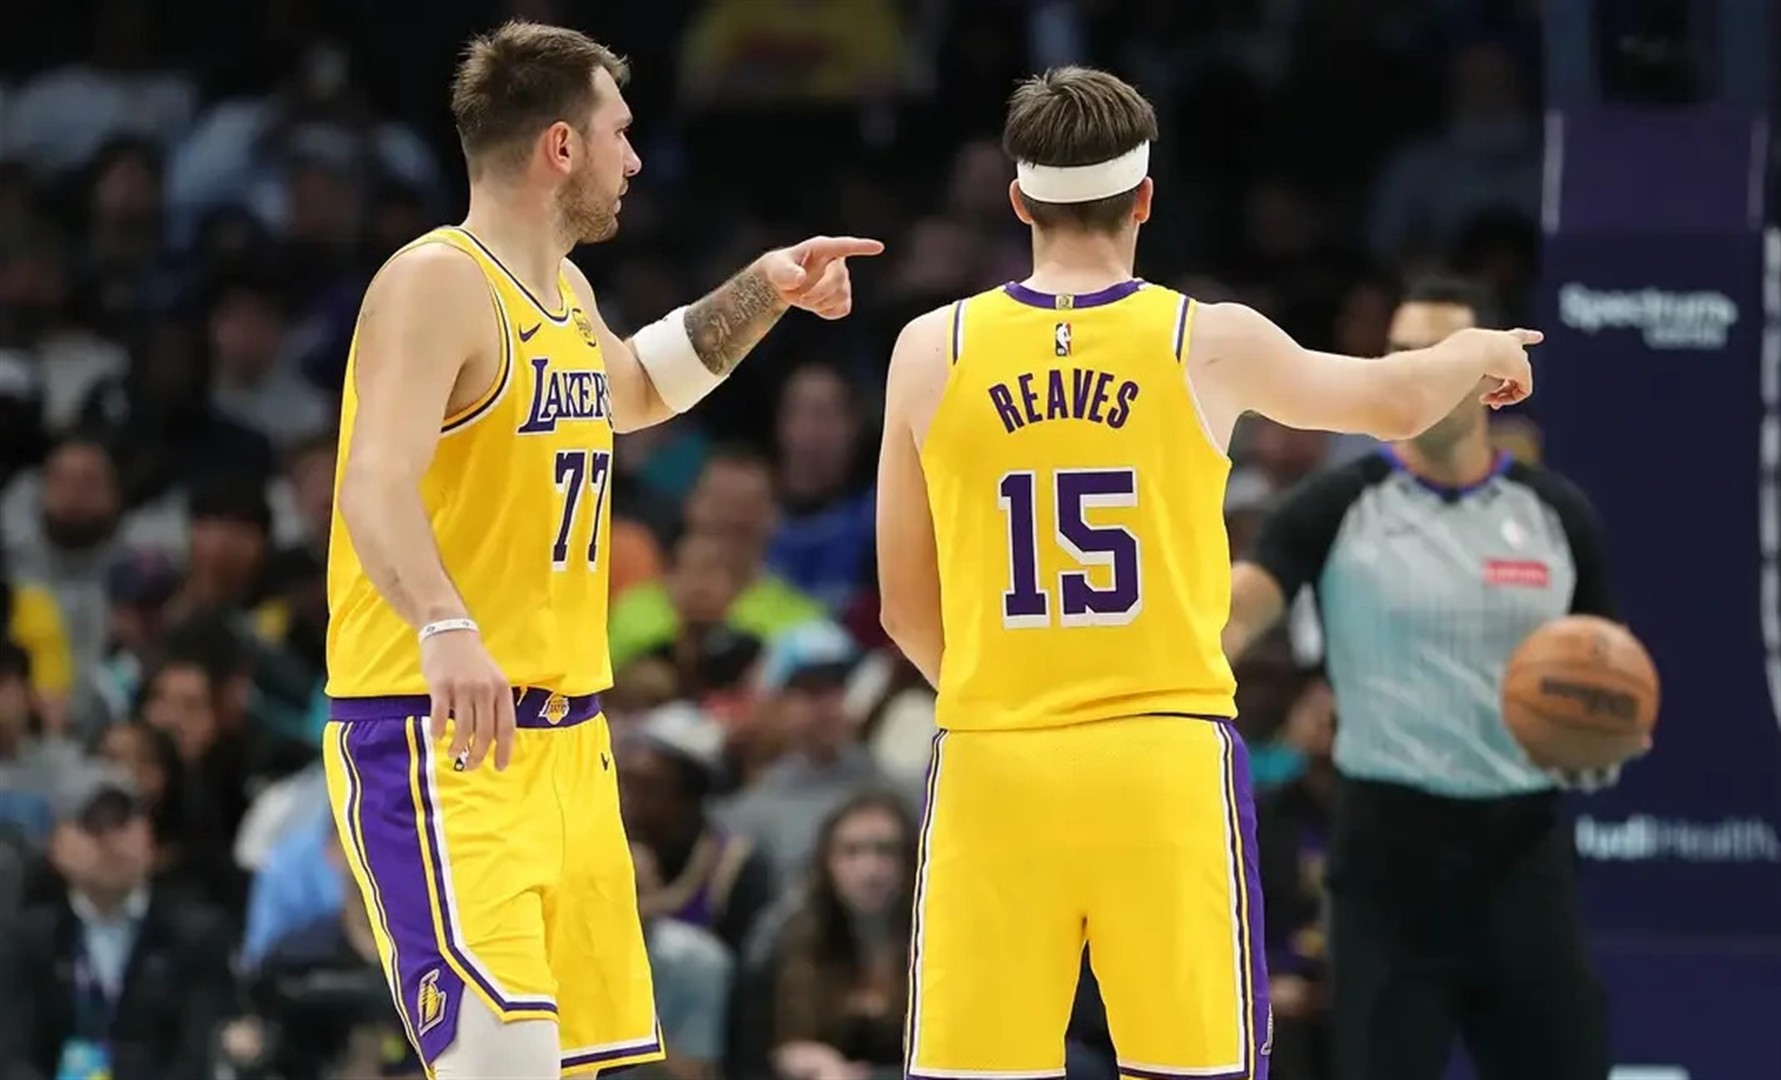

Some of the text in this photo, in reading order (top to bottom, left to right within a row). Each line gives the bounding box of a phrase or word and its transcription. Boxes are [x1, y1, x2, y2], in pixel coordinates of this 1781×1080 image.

[988, 368, 1139, 433] REAVES
[551, 450, 610, 572] 77
[998, 468, 1143, 630] 15
